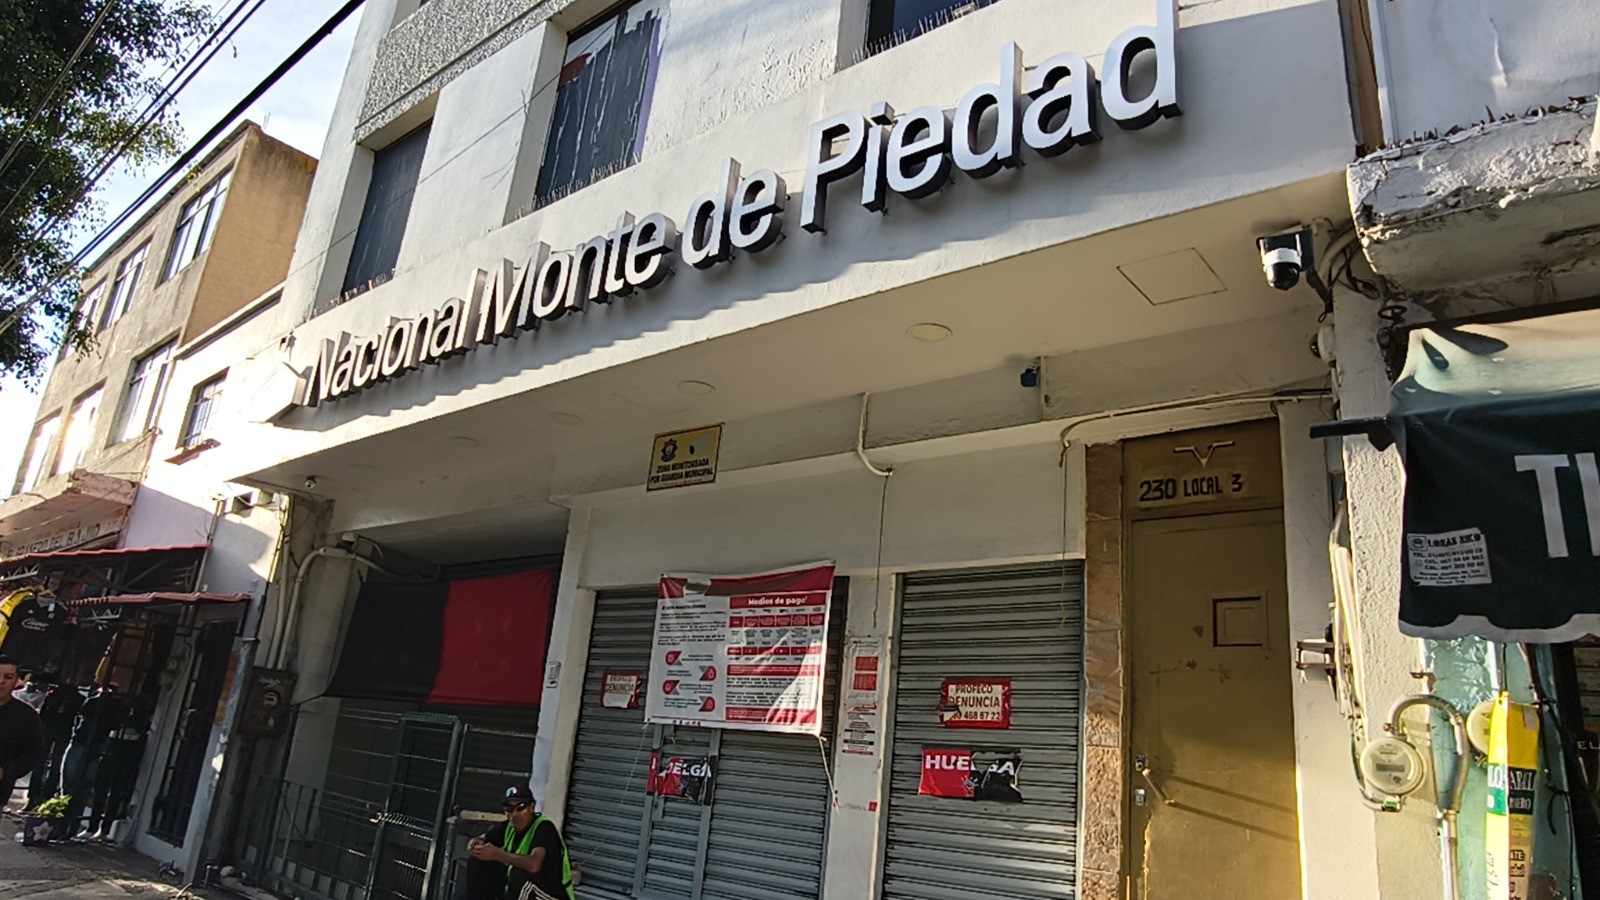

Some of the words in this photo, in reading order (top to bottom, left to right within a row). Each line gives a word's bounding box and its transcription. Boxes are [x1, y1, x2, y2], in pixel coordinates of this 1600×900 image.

[304, 268, 487, 406] Nacional
[476, 211, 675, 343] Monte
[682, 157, 786, 268] de
[801, 0, 1181, 232] Piedad
[656, 464, 671, 474] ZONA
[672, 458, 709, 470] MONITOREADA
[650, 474, 660, 484] POR
[661, 471, 683, 481] GUARDIA
[684, 467, 713, 478] MUNICIPAL
[1140, 478, 1177, 502] 230
[1183, 475, 1223, 497] LOCAL
[1231, 473, 1243, 493] 3
[748, 597, 773, 606] Medios
[955, 685, 993, 694] PROFECO
[990, 711, 1000, 720] 22
